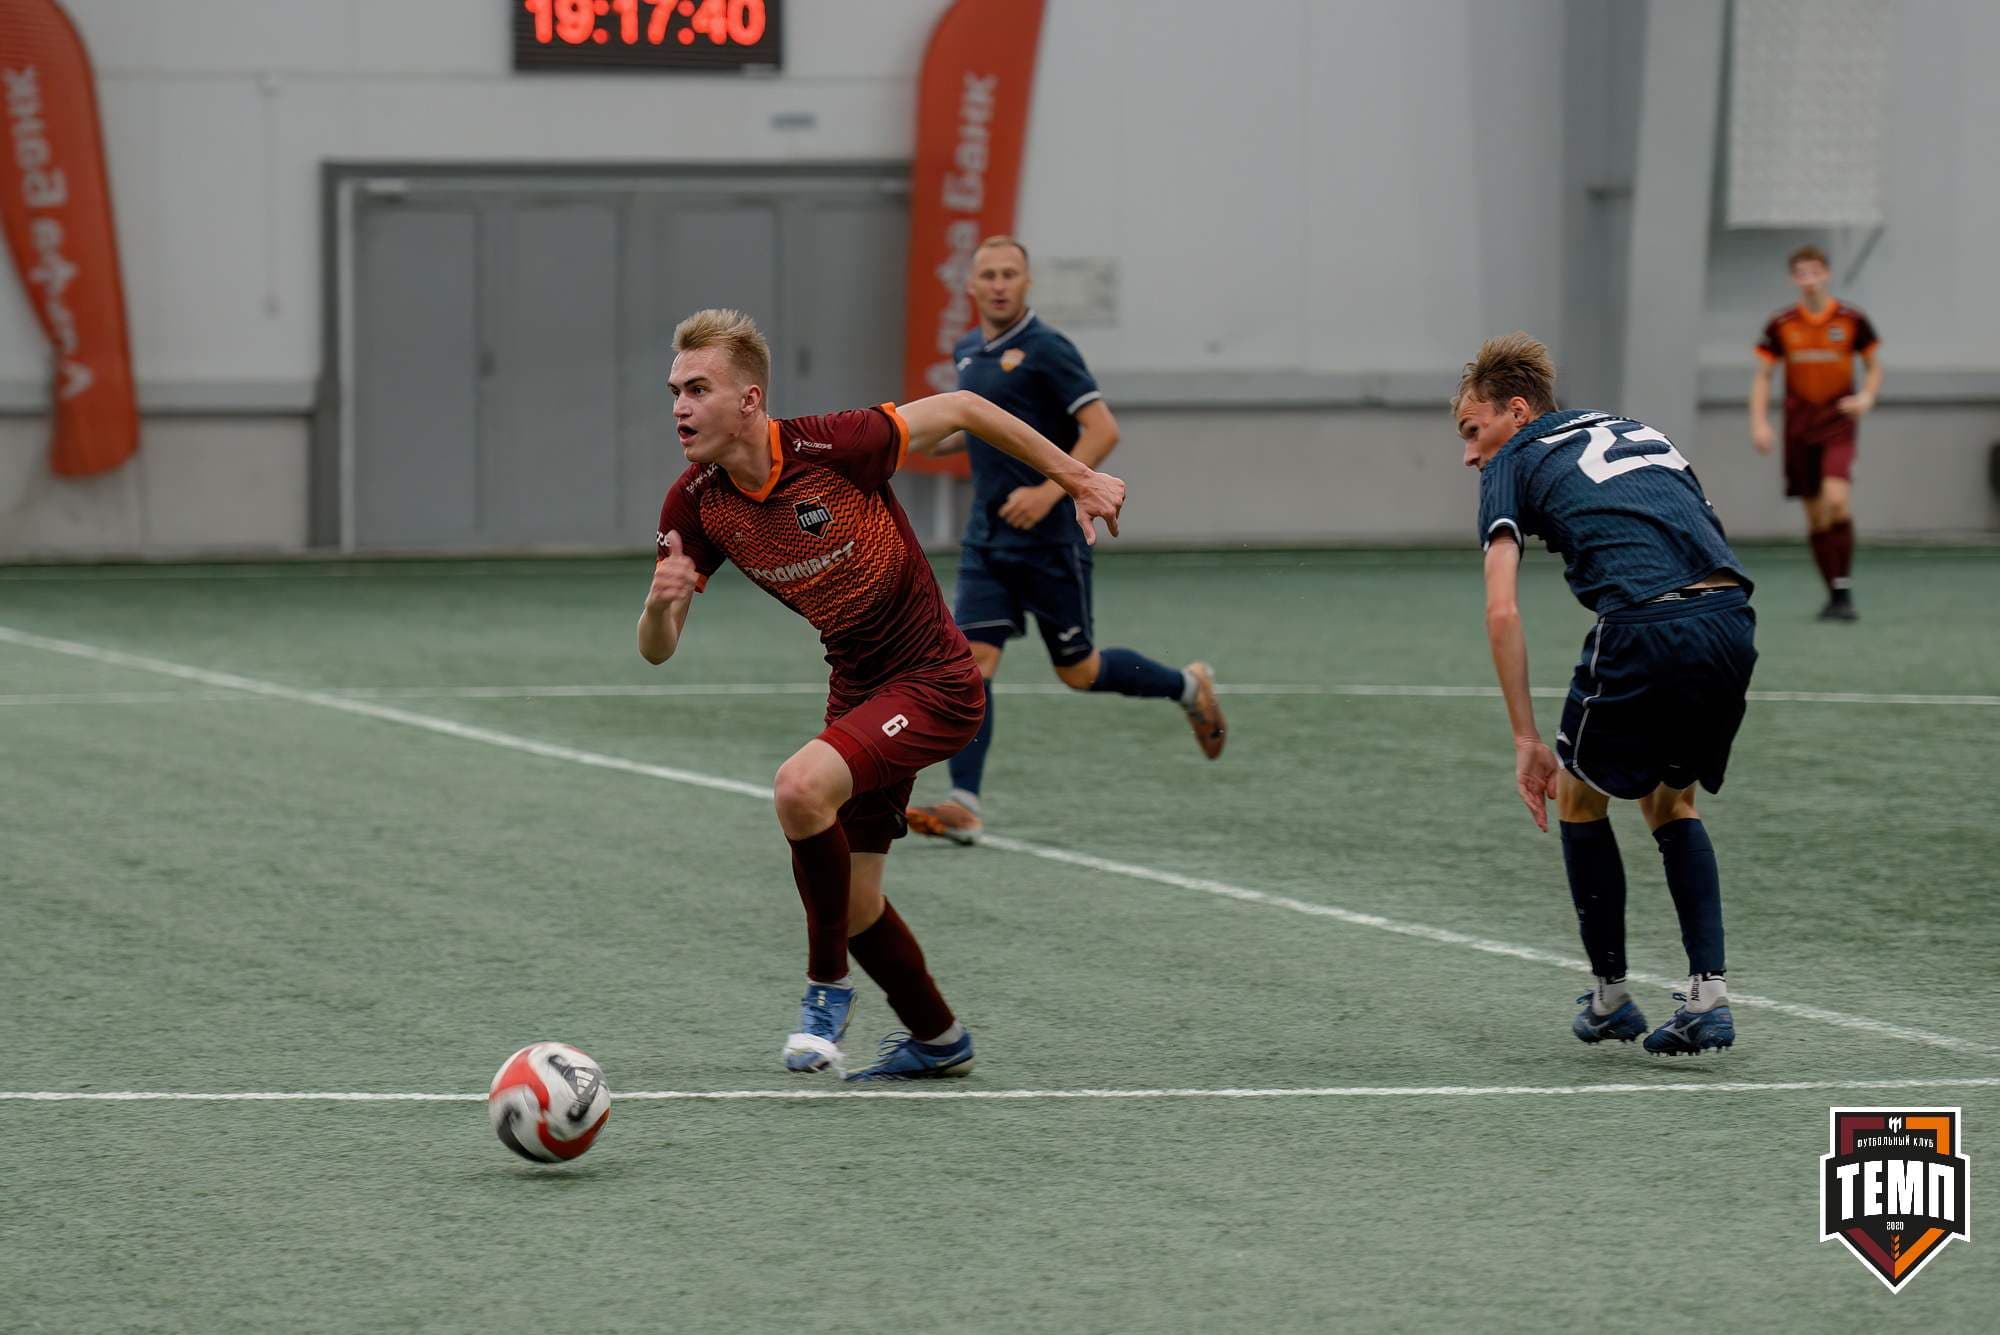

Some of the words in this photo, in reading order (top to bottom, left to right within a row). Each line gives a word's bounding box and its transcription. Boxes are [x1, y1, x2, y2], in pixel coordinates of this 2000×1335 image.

[524, 0, 766, 46] 19:17:40
[798, 508, 830, 528] ТЕМП
[881, 713, 910, 738] 6
